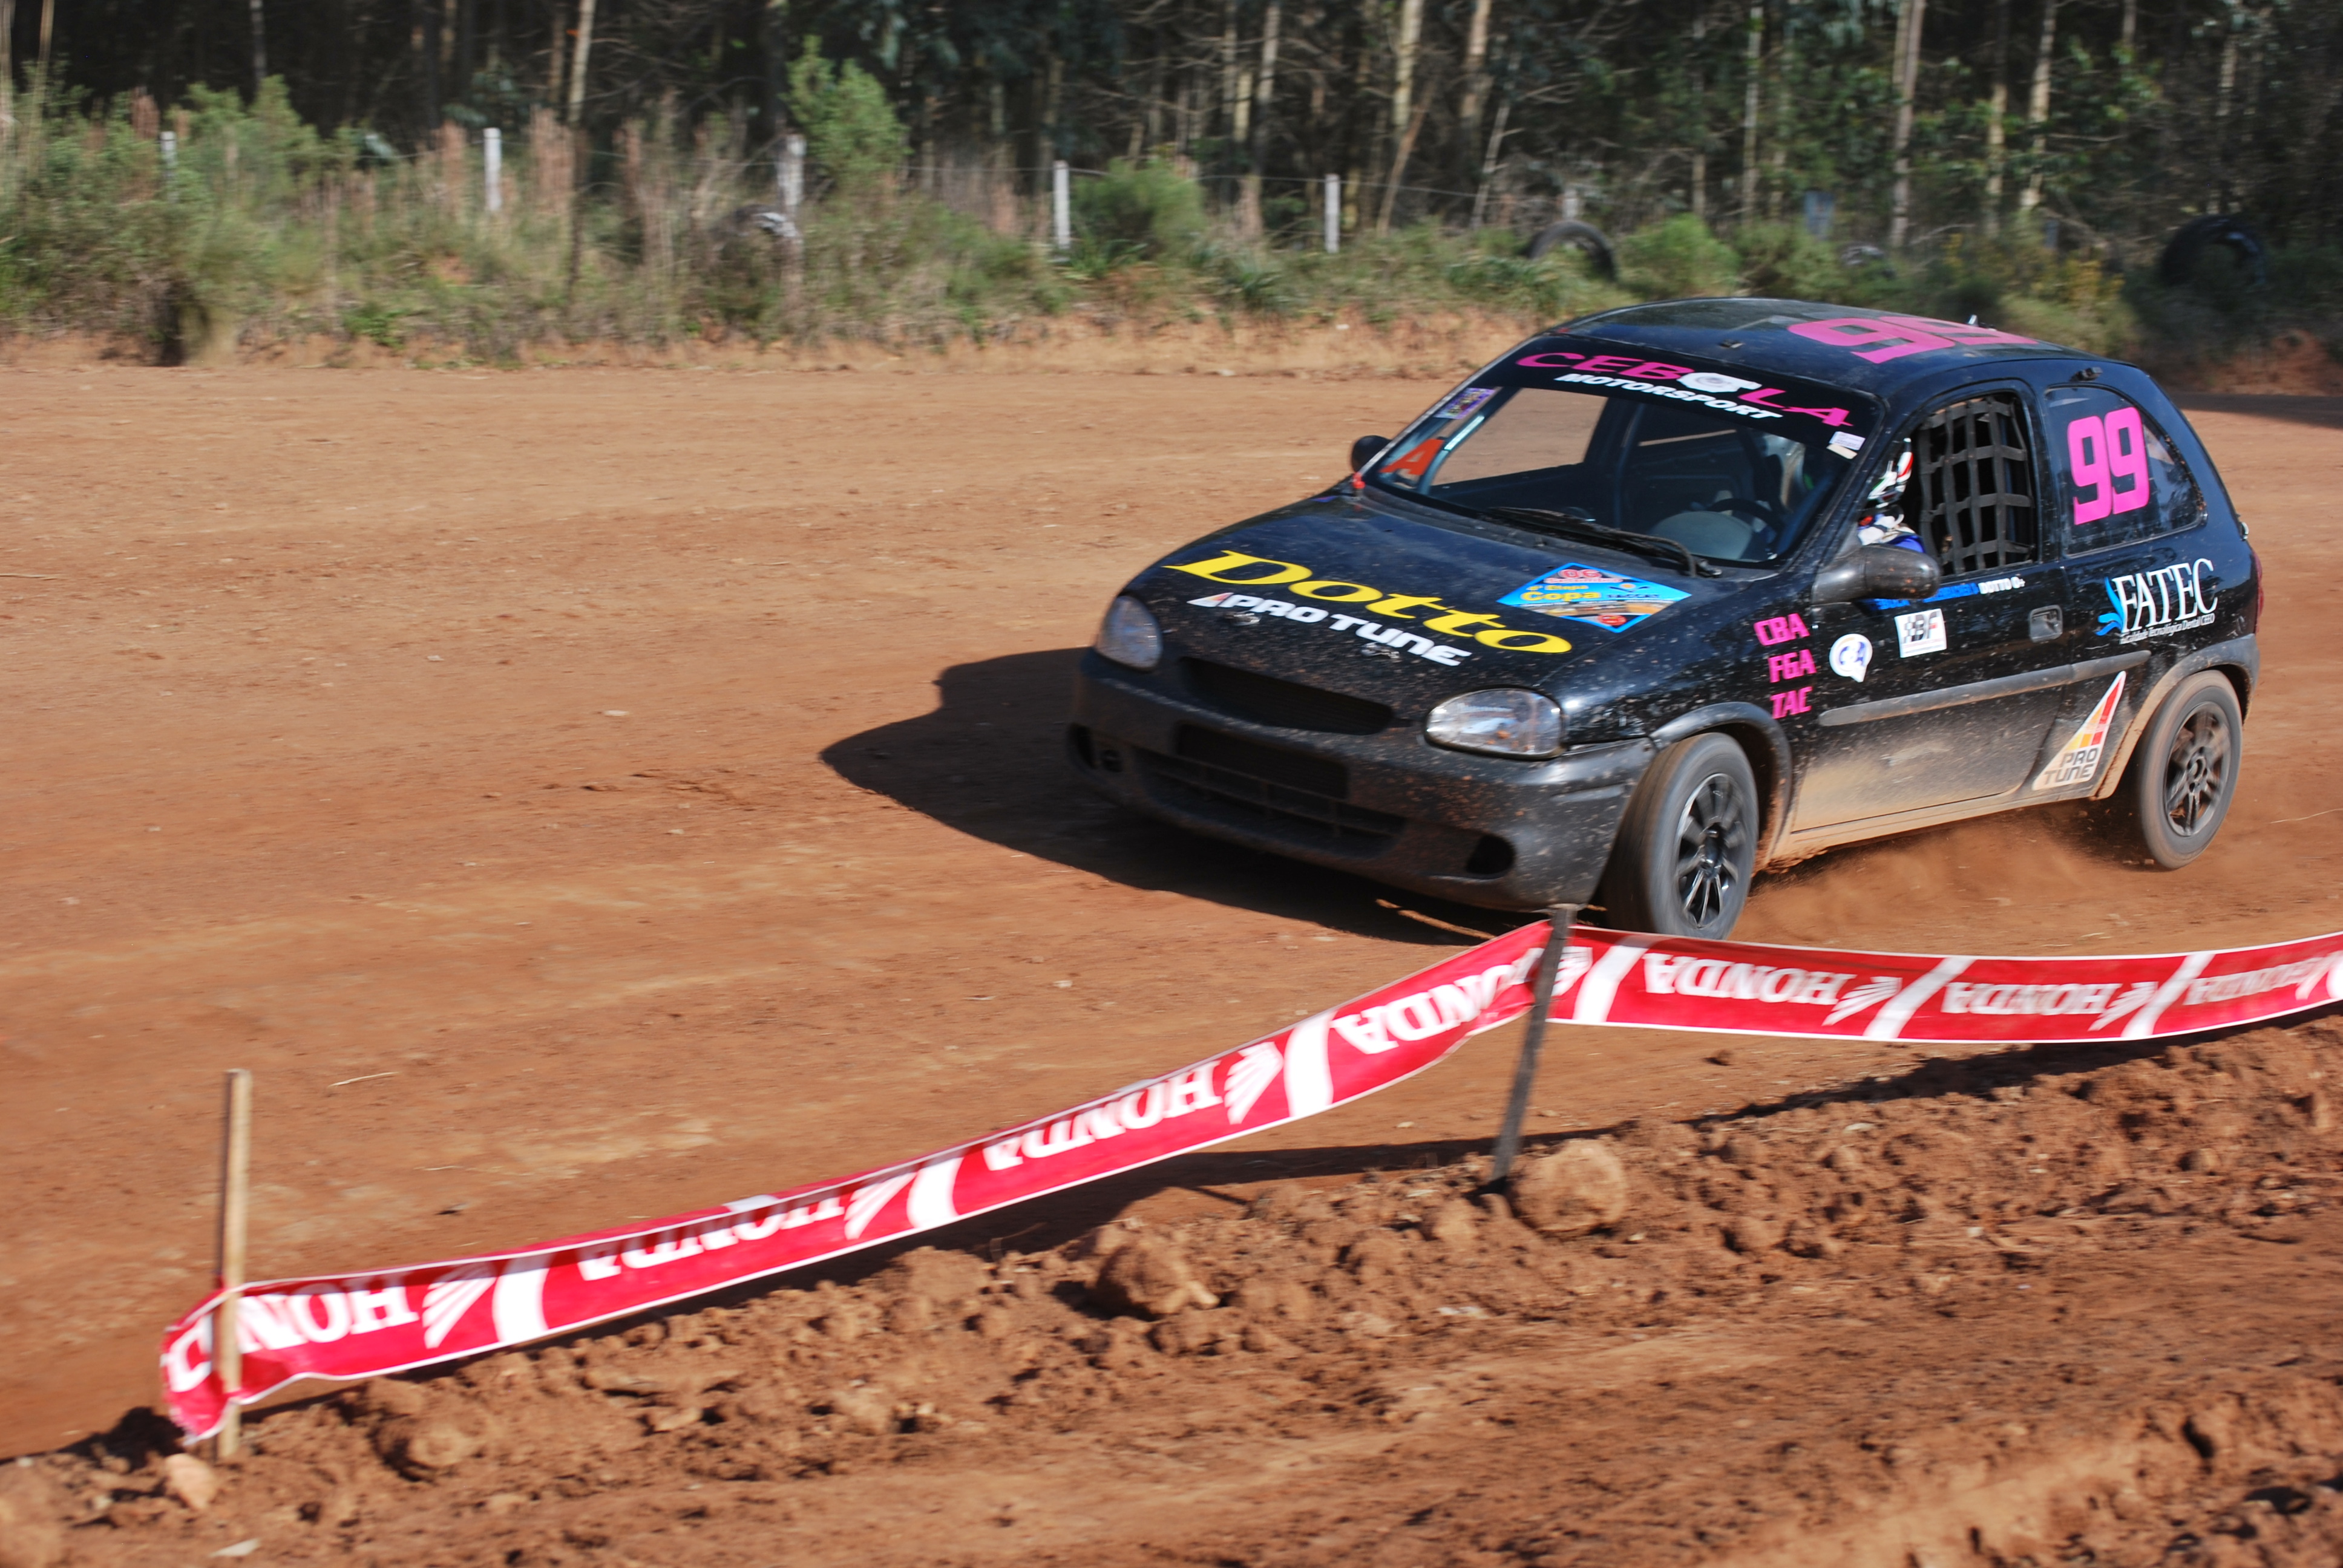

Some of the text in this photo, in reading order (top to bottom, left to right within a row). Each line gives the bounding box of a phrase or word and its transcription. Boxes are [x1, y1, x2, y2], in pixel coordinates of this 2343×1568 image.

[1788, 316, 2039, 364] 99
[1554, 373, 1783, 419] MOTORSPORT
[1378, 439, 1445, 475] A
[2067, 407, 2150, 525] 99
[1162, 550, 1572, 653] Dotto
[1521, 592, 1602, 602] Copa
[2112, 558, 2218, 634] FATEC
[1224, 594, 1472, 666] PRO TUNE
[1754, 613, 1810, 645] CBA
[1768, 649, 1817, 683] FGA
[1769, 686, 1814, 719] TAC
[2044, 763, 2094, 785] TUNE
[2060, 747, 2099, 767] PRO
[1642, 953, 1856, 1005] HONDA
[1941, 981, 2122, 1016] HONDA
[982, 1060, 1224, 1171] HONDA
[165, 1275, 419, 1393] HOND
